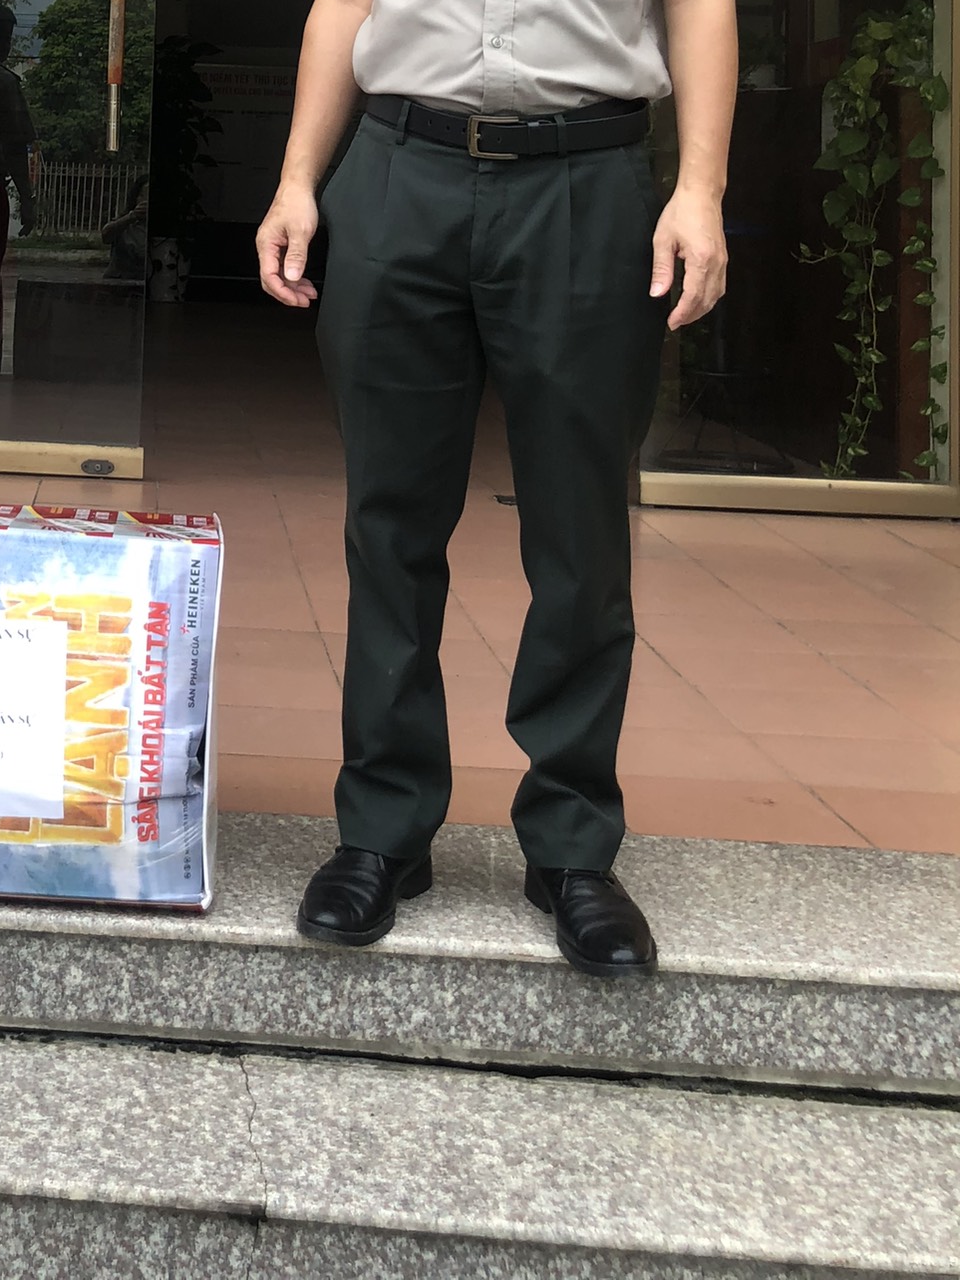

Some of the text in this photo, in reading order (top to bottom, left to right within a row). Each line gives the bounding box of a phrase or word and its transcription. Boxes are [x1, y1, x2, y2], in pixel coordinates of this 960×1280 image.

[187, 559, 201, 628] HEINEKEN
[138, 654, 168, 706] BẤT
[138, 709, 165, 783] KHOÁI
